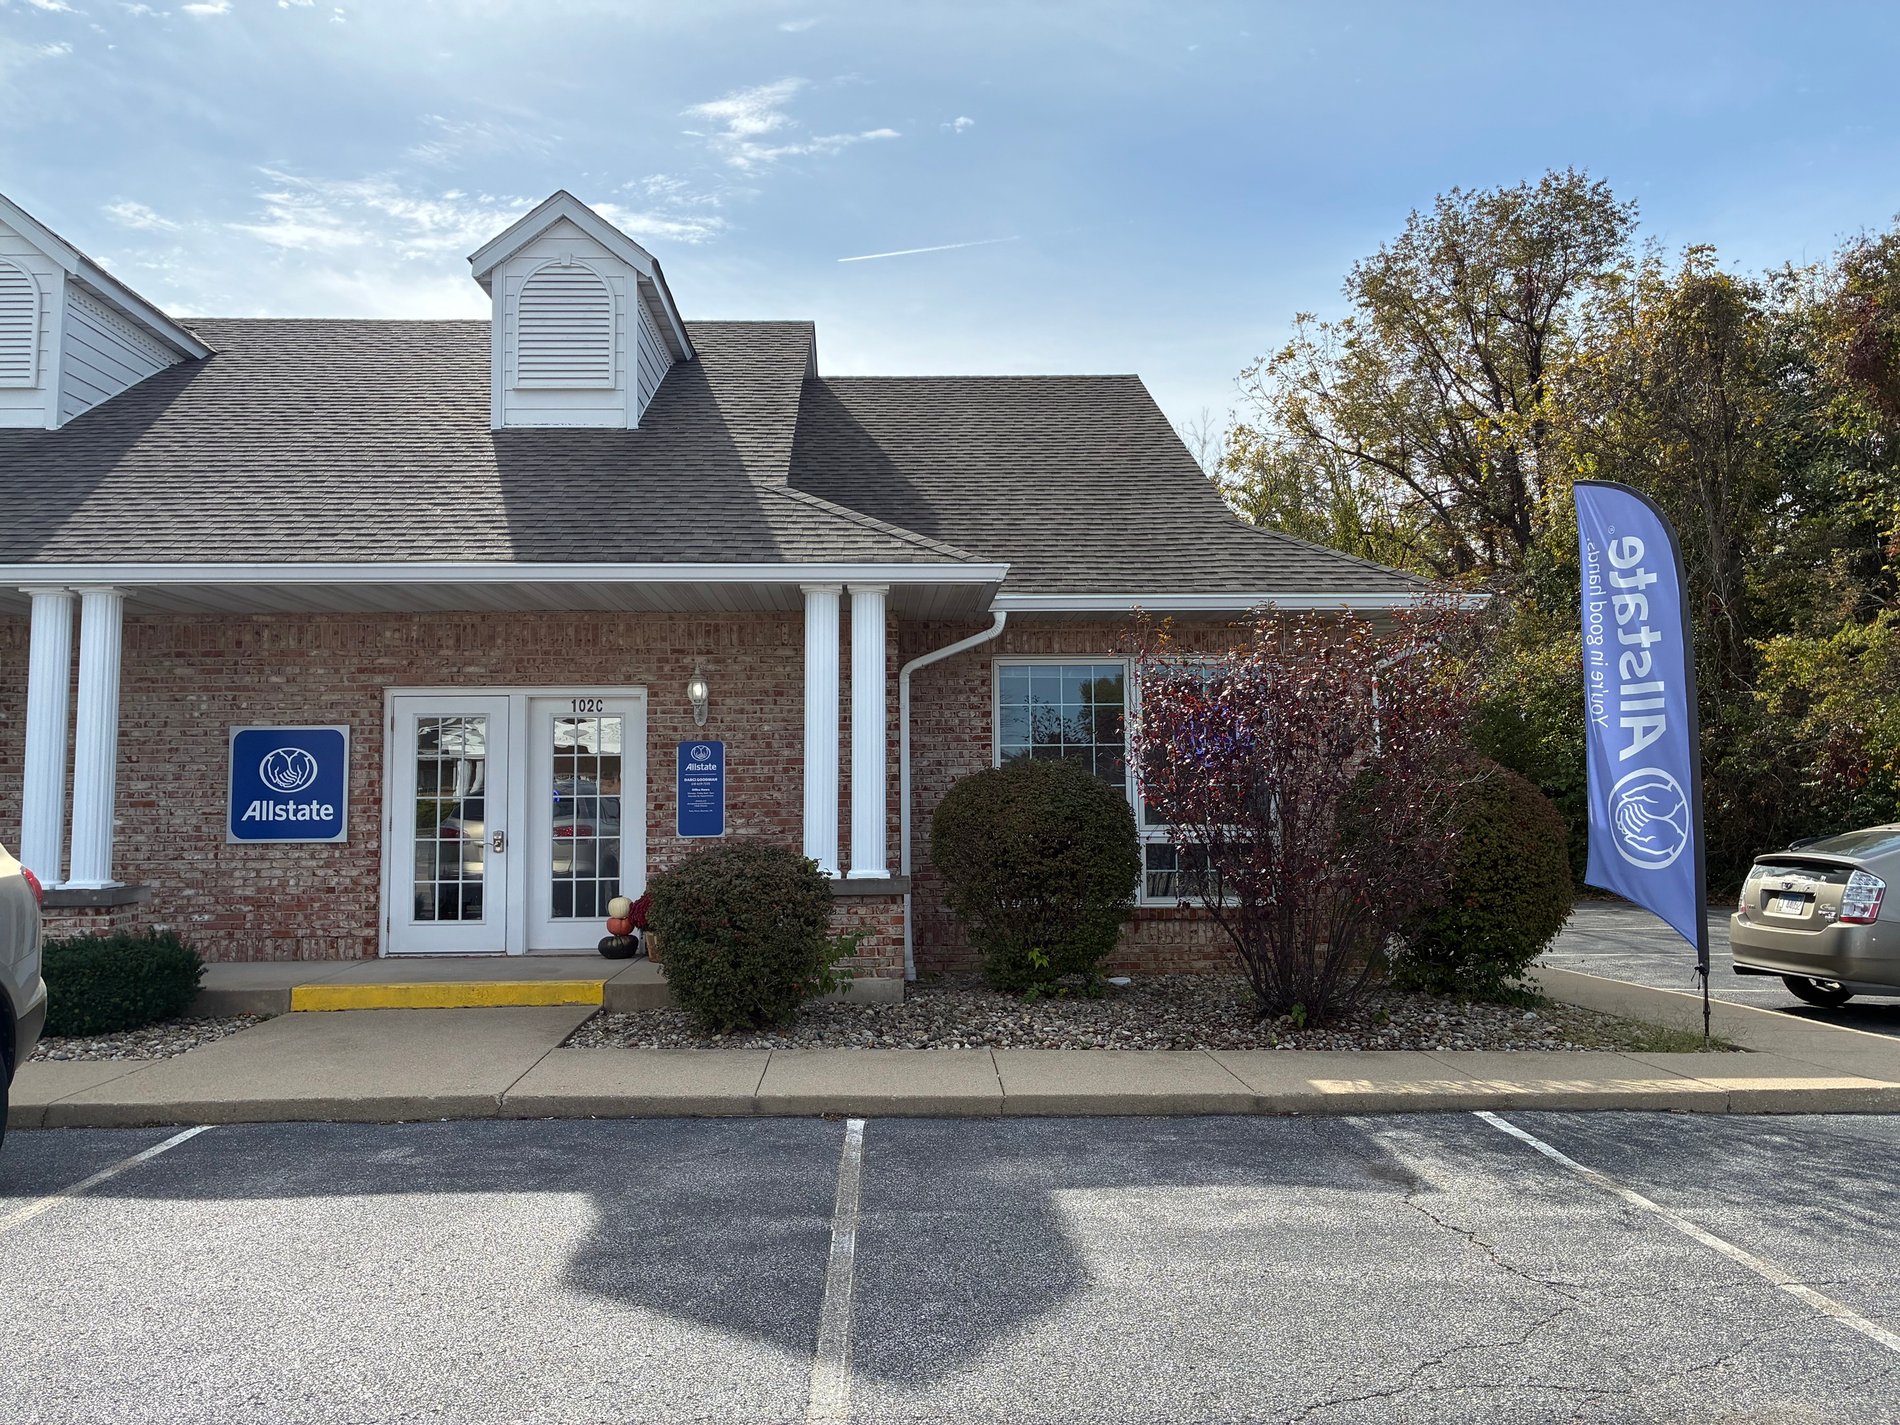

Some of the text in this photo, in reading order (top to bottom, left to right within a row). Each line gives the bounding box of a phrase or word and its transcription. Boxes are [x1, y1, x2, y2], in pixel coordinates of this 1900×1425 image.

[571, 698, 603, 713] 102C
[685, 763, 717, 771] Allstate
[240, 799, 334, 821] Allstate
